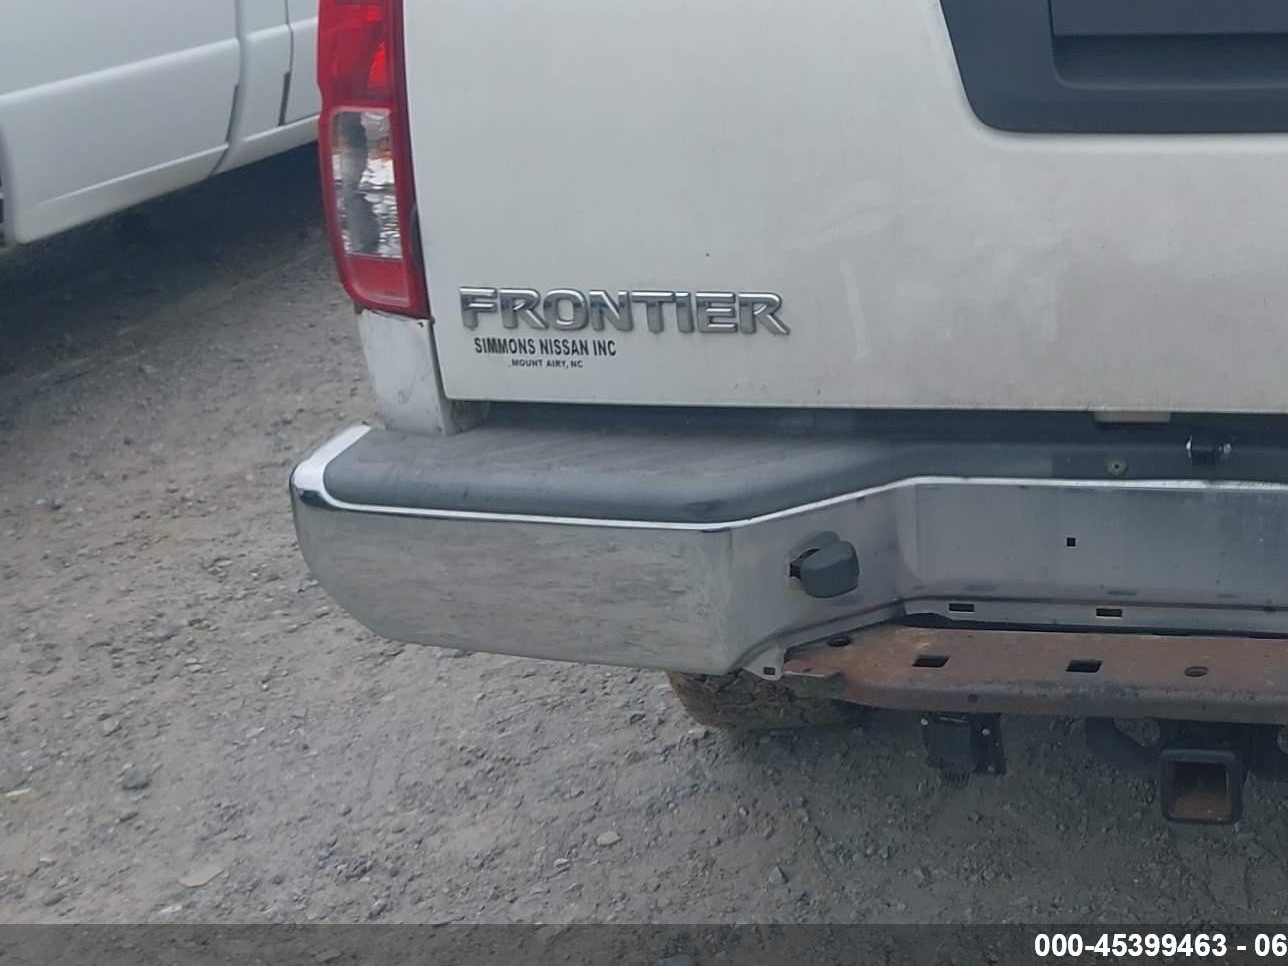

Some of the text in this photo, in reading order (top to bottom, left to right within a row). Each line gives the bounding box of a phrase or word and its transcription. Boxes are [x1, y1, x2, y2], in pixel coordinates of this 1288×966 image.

[459, 286, 791, 336] FRONTIER
[474, 337, 617, 357] SIMMONS NISSAN INC
[511, 358, 543, 368] MOUNT
[571, 360, 583, 369] NC
